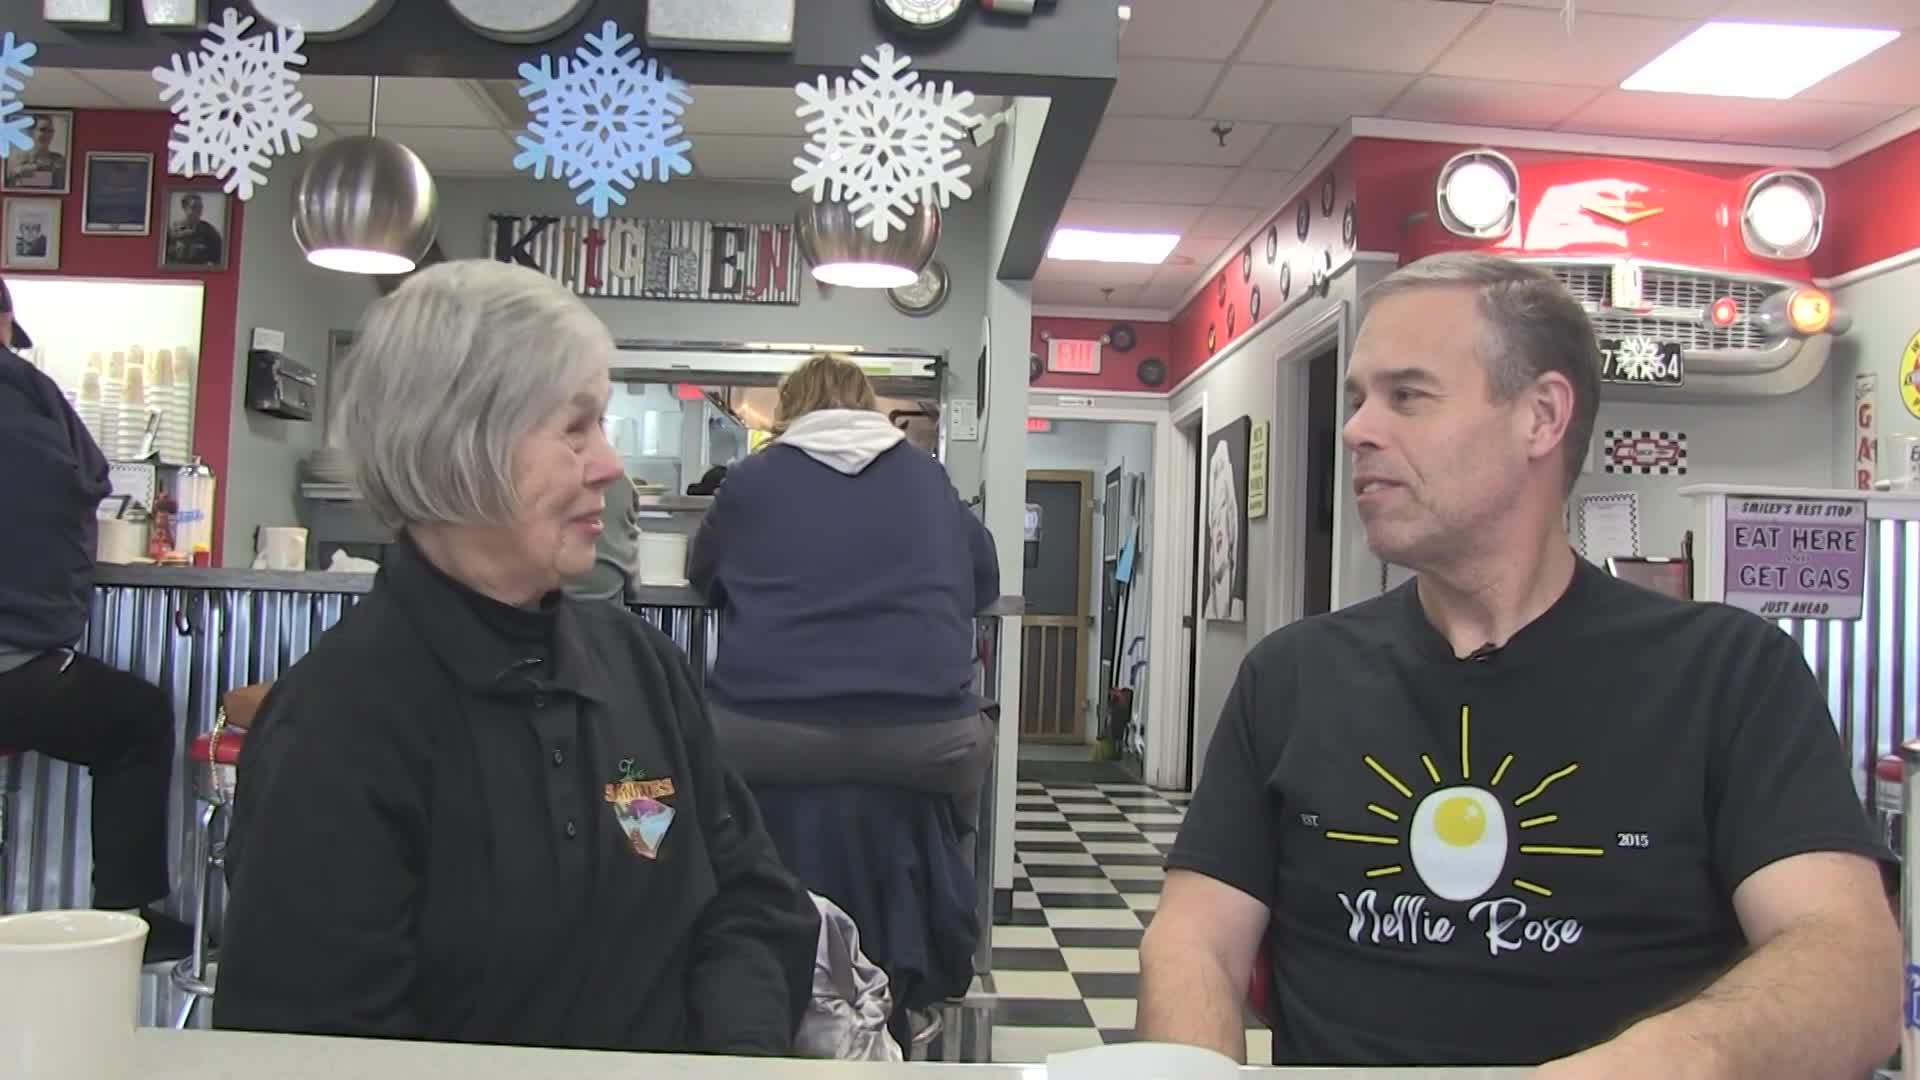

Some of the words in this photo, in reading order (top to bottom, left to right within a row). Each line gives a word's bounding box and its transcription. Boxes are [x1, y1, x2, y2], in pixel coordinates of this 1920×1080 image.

[1742, 502, 1792, 515] SMILEY'S
[1824, 505, 1854, 517] STOP
[1735, 527, 1781, 548] EAT
[1792, 529, 1857, 552] HERE
[1740, 565, 1788, 588] GET
[1799, 567, 1851, 590] GAS
[1760, 602, 1789, 613] JUST
[1791, 602, 1830, 615] AHEAD
[1617, 832, 1649, 848] 2015
[1337, 889, 1456, 944] Nellie
[1468, 896, 1584, 955] Rose
